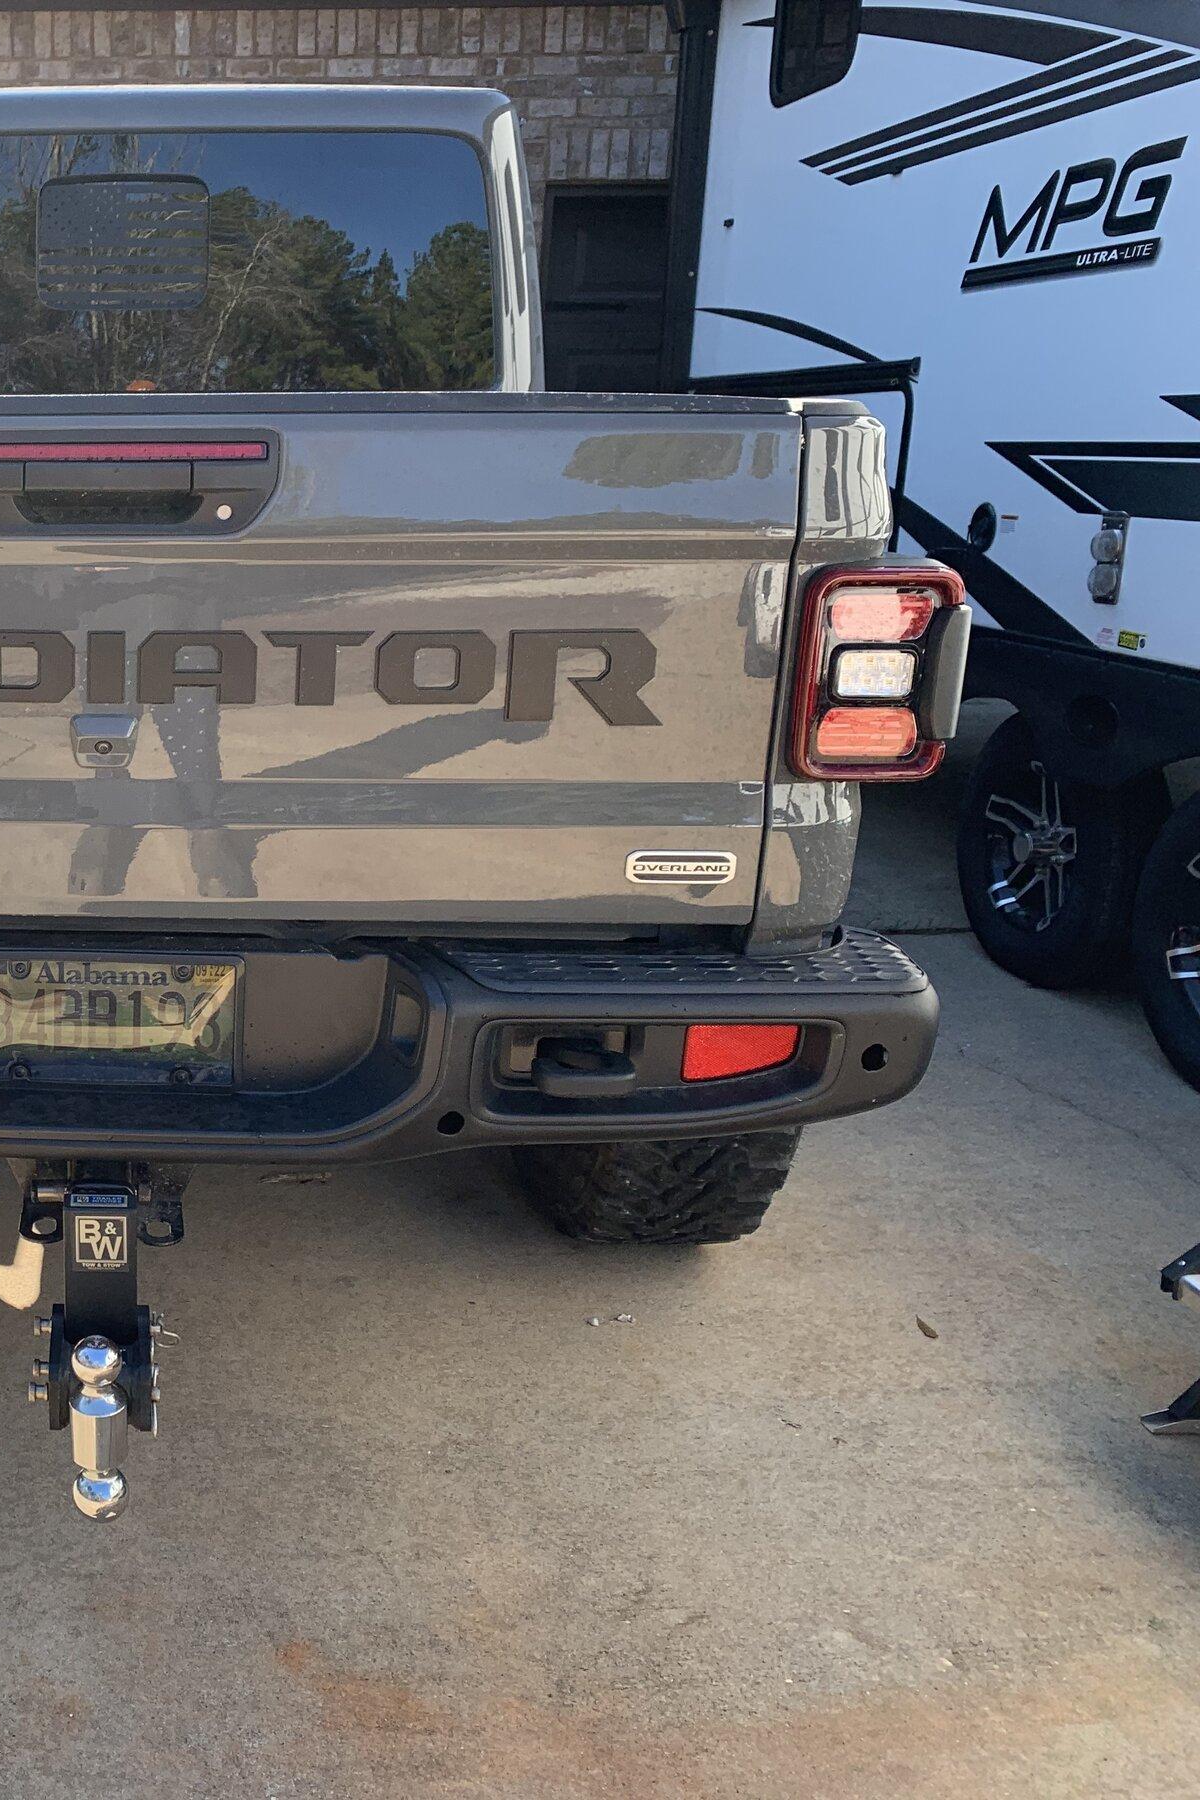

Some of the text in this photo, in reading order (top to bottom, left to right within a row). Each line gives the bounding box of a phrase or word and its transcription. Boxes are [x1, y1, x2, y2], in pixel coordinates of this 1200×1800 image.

[968, 135, 1189, 264] MPG
[1076, 242, 1154, 266] ULTRA-LITE
[632, 864, 731, 873] OVERLAND
[34, 961, 169, 986] Alabama
